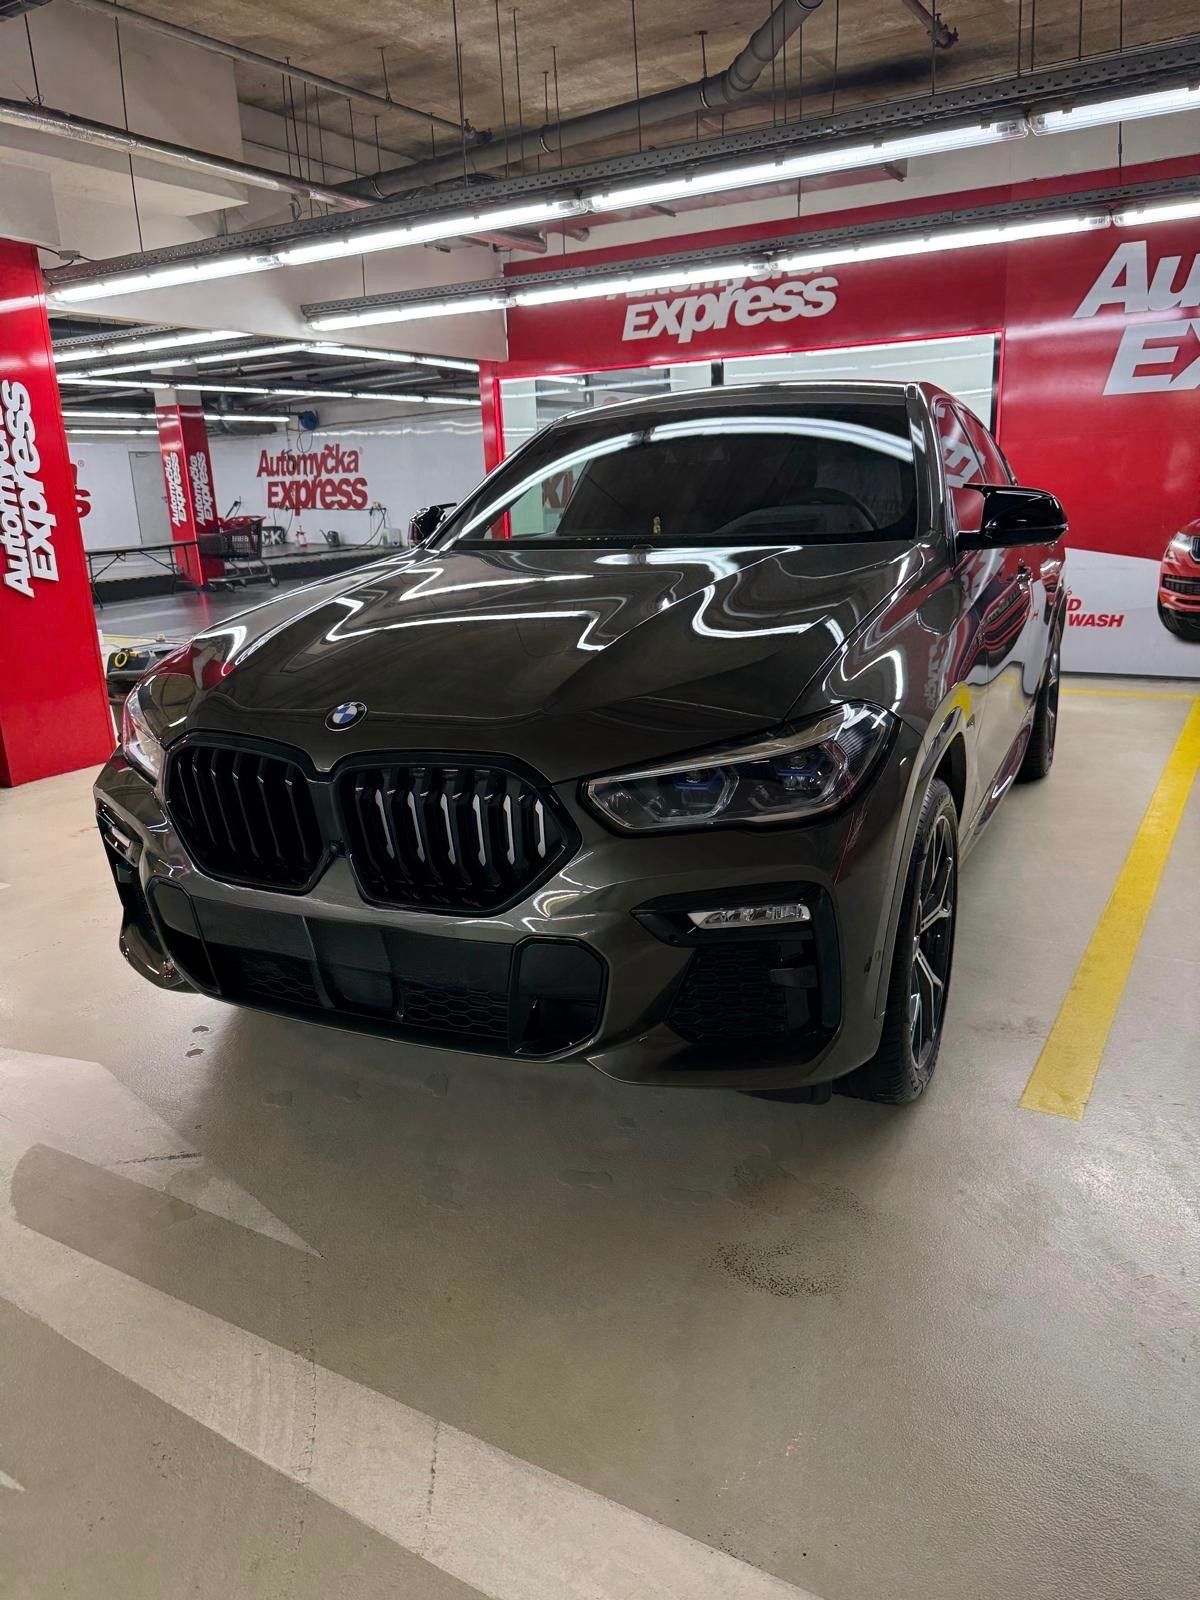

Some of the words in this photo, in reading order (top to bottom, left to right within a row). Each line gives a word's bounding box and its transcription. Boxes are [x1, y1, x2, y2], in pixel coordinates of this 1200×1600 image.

[621, 276, 839, 344] Express
[2, 379, 59, 581] Express
[256, 443, 359, 479] Automyčka
[268, 477, 368, 516] Express
[1068, 613, 1124, 628] WASH
